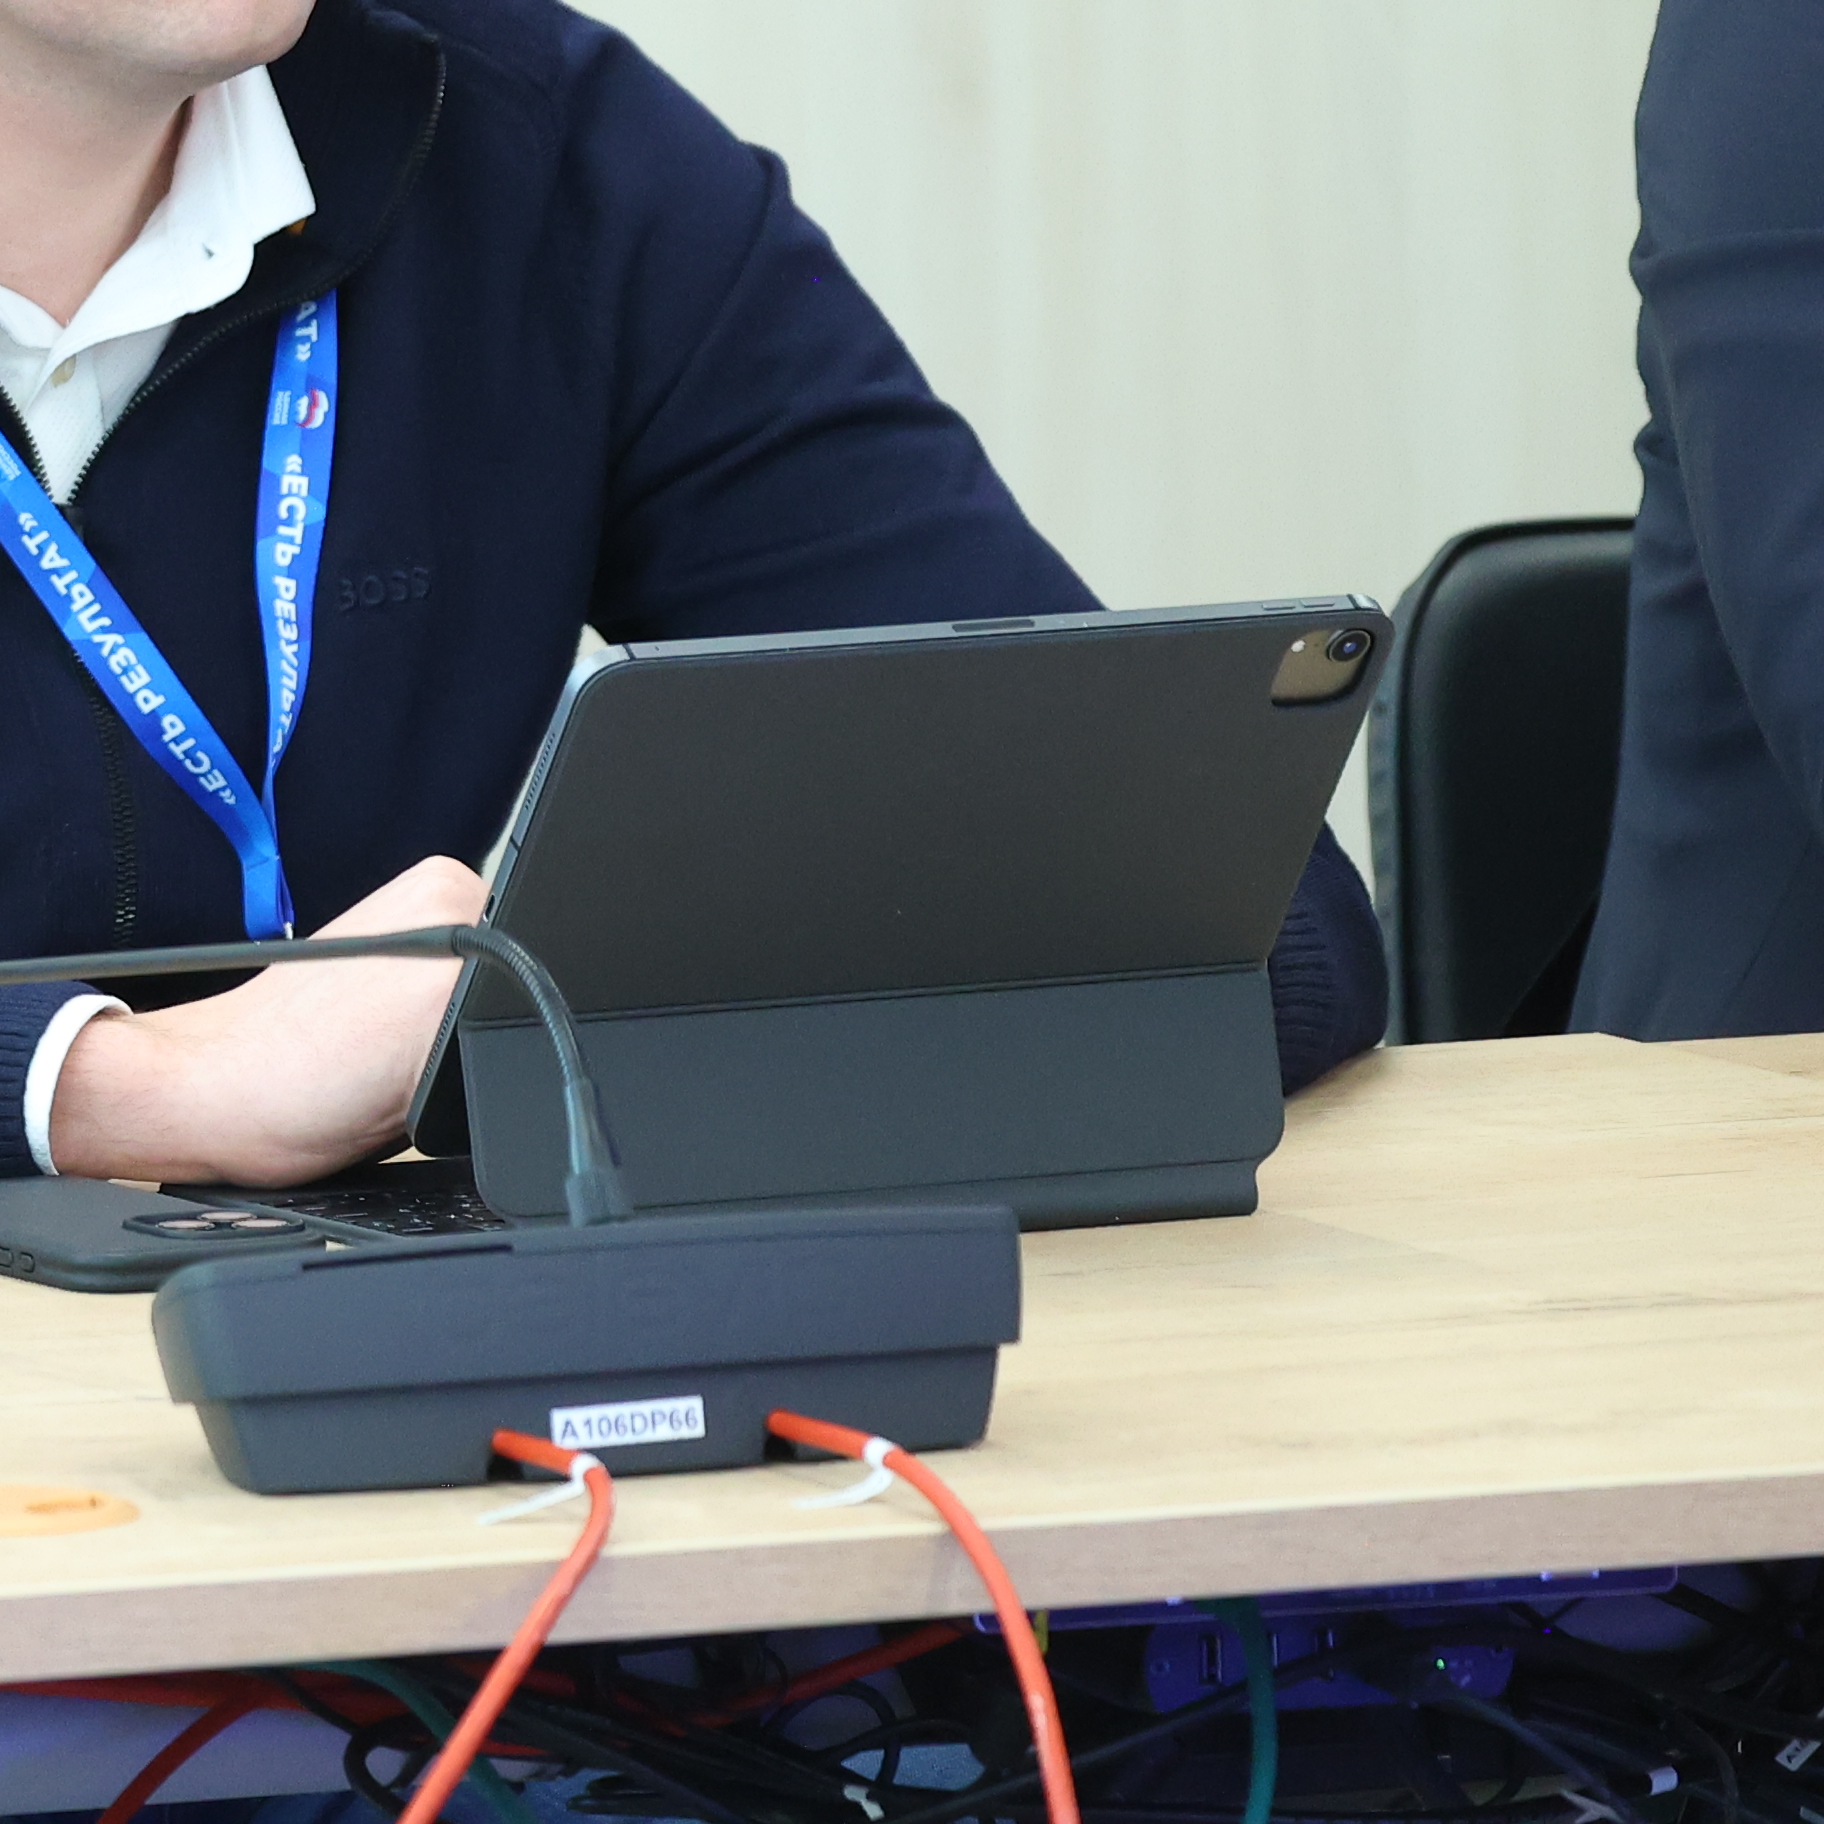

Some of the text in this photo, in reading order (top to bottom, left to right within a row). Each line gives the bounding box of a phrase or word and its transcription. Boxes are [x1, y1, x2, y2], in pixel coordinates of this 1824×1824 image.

[273, 454, 309, 567] «ЕСТЬ
[18, 512, 237, 805] «ЕСТЬ РЕЗУЛЬТАТ»
[560, 1406, 699, 1444] A106DP66
